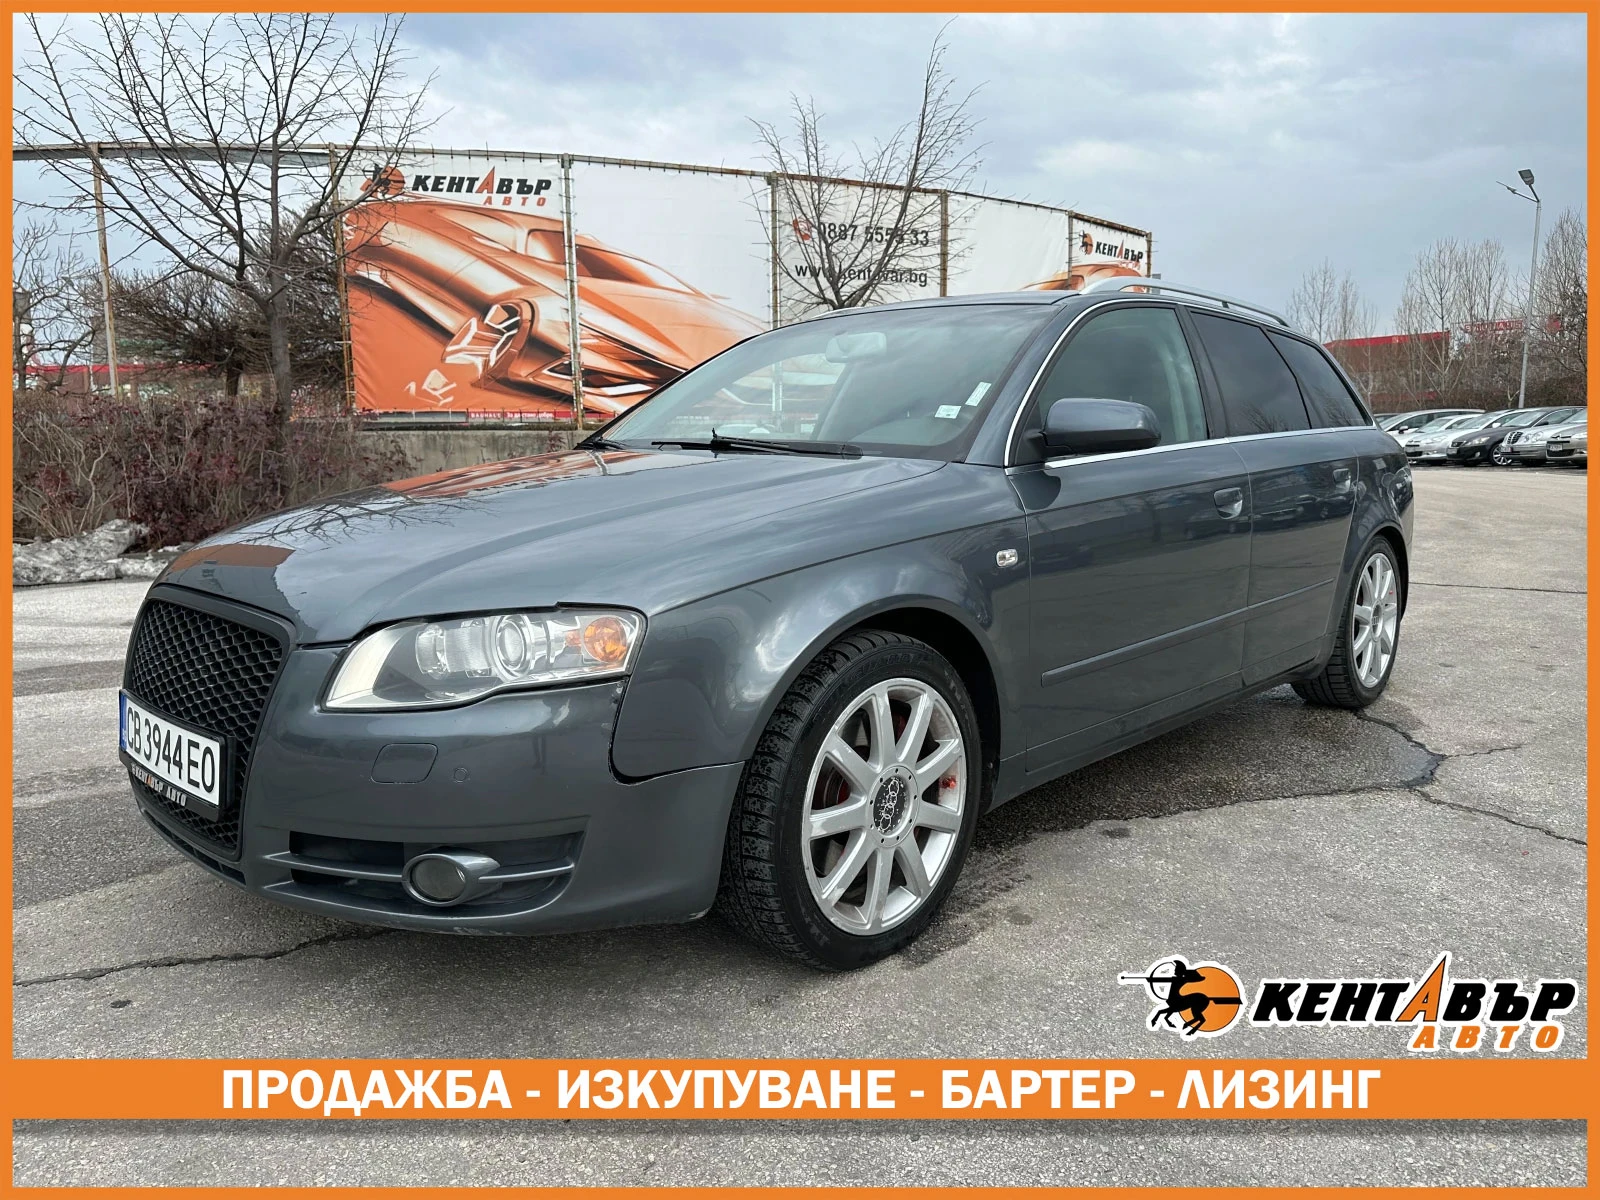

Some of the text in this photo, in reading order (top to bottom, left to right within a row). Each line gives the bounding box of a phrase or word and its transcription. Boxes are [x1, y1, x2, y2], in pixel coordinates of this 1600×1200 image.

[412, 166, 552, 195] КЕНТАВЪР
[483, 195, 547, 207] АВТО
[910, 229, 930, 246] 33
[1095, 238, 1144, 262] КЕНТАВЪР
[165, 786, 187, 807] АВТО
